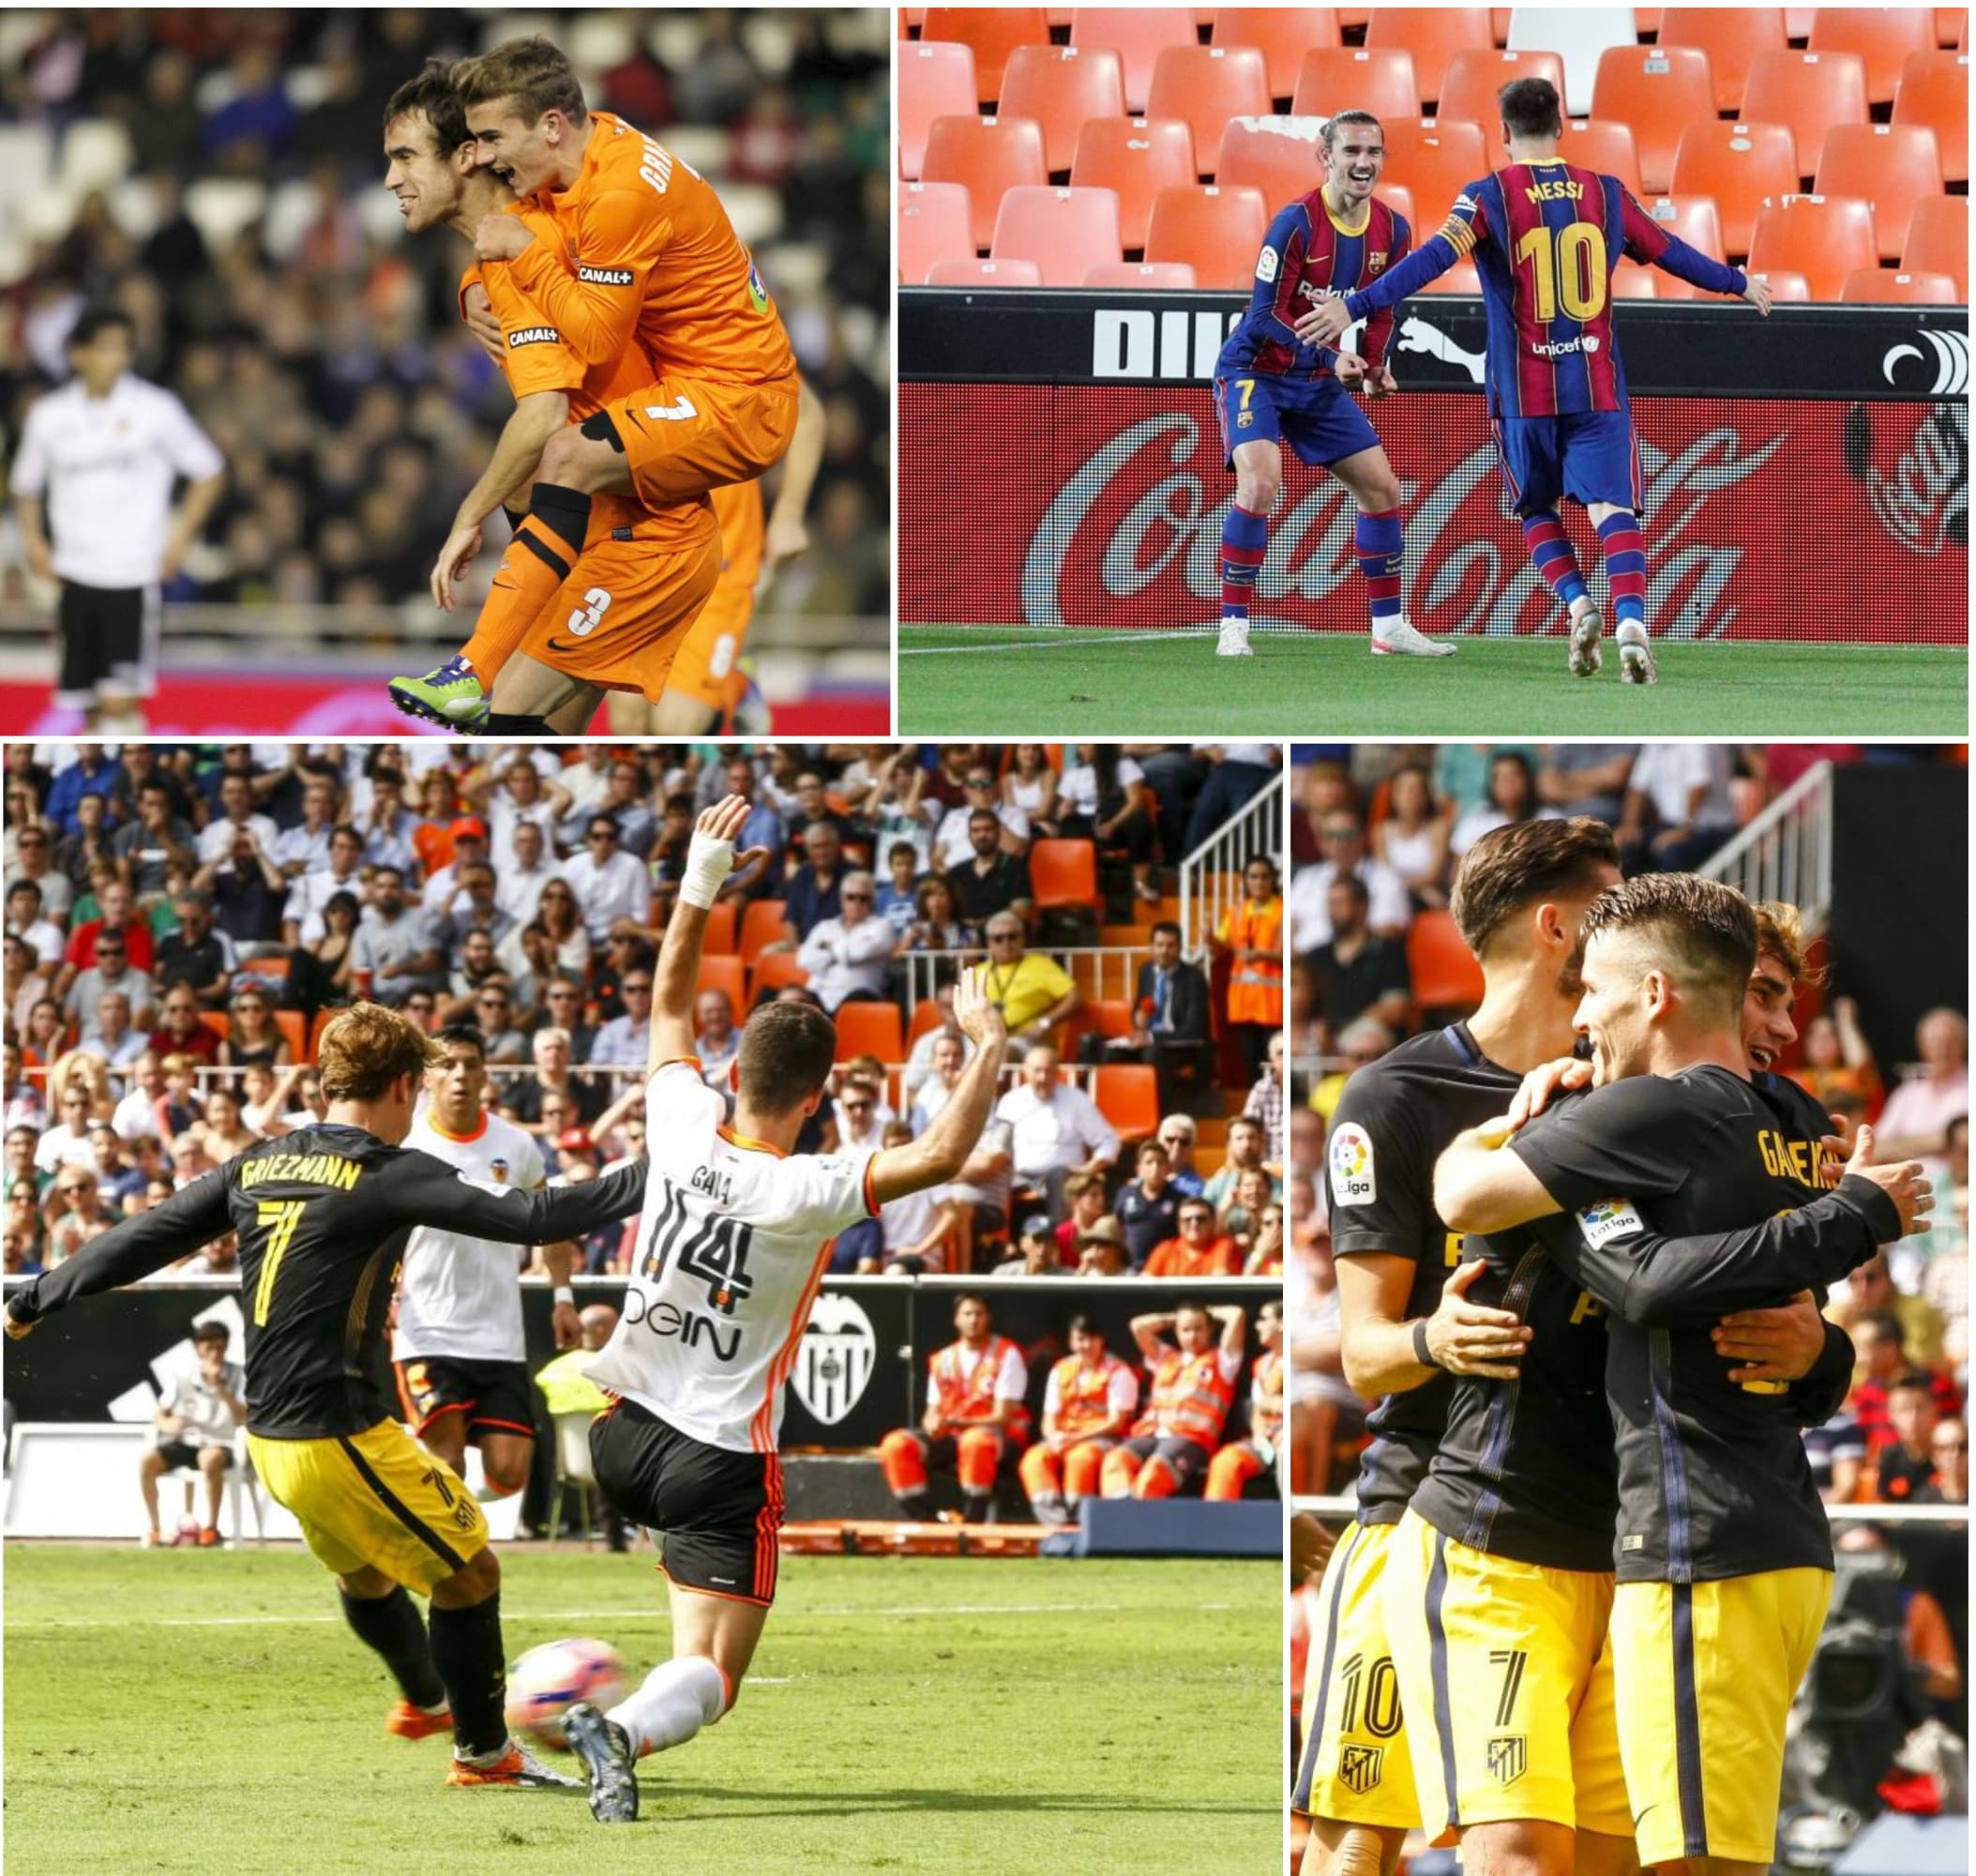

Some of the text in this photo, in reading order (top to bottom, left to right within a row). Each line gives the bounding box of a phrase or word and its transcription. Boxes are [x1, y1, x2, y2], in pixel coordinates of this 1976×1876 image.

[1525, 180, 1584, 204] MESSI
[579, 267, 632, 284] CANAL+
[1516, 221, 1607, 324] 10
[509, 328, 558, 347] CANAL+
[1532, 337, 1581, 356] unicef
[644, 394, 698, 421] 7
[1235, 379, 1255, 410] 7
[567, 587, 611, 636] 3
[242, 1154, 362, 1191] GRIEZMANN
[254, 1201, 307, 1327] 7
[641, 1176, 752, 1315] 14
[421, 1469, 455, 1509] 7
[1341, 1653, 1403, 1738] 10
[1489, 1651, 1528, 1727] 7
